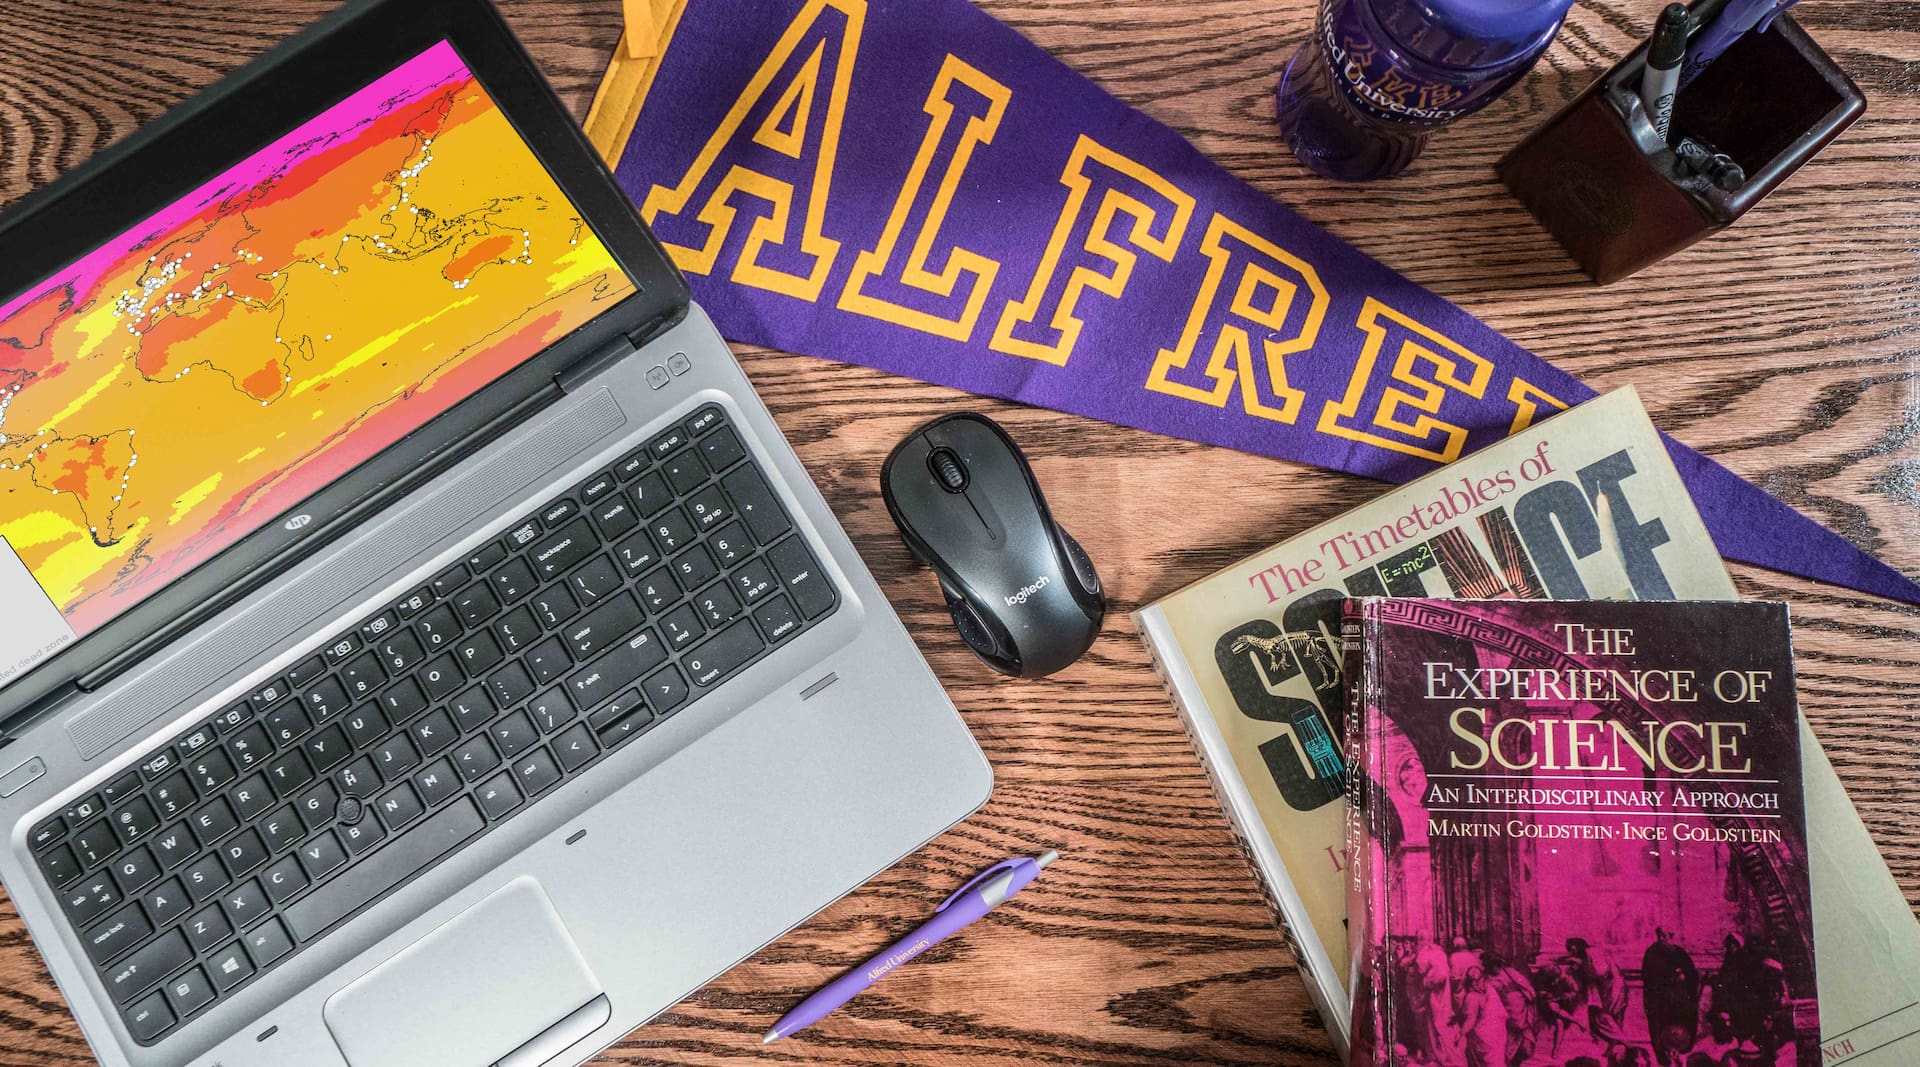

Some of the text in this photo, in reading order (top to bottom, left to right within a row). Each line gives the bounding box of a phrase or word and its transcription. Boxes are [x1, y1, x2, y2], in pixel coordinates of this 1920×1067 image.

[1344, 58, 1466, 119] University
[639, 0, 1570, 464] ALFRE
[626, 460, 639, 471] end
[587, 482, 605, 495] home
[548, 506, 567, 520] delete
[696, 504, 705, 513] 9
[286, 514, 311, 530] hp
[1249, 441, 1557, 604] The Timetables of
[512, 524, 532, 538] insert
[660, 527, 669, 536] 8
[719, 540, 728, 549] 6
[538, 539, 571, 561] backspace
[623, 549, 631, 559] 7
[630, 555, 649, 568] home
[682, 563, 691, 573] 5
[741, 577, 750, 586] 3
[792, 571, 808, 585] enter
[647, 586, 655, 595] 4
[1004, 574, 1050, 607] logitech
[705, 600, 714, 610] 2
[670, 623, 677, 631] 1
[774, 621, 793, 636] delete
[432, 634, 441, 643] 0
[574, 627, 590, 640] enter
[676, 631, 689, 641] end
[45, 634, 69, 652] zone
[1554, 623, 1636, 656] THE
[466, 648, 474, 658] P
[395, 658, 403, 667] 9
[692, 661, 701, 670] 0
[429, 671, 440, 681] O
[700, 669, 719, 682] insert
[357, 682, 366, 691] 8
[1423, 662, 1772, 703] EXPERIENCE OF
[390, 698, 397, 706] I
[319, 705, 327, 715] 7
[459, 705, 469, 714] L
[353, 719, 363, 729] U
[282, 729, 290, 738] 6
[421, 726, 432, 737] K
[1449, 707, 1751, 774] SCIENCE
[315, 742, 324, 752] Y
[244, 753, 252, 763] 5
[384, 751, 392, 761] J
[276, 767, 285, 777] T
[206, 777, 214, 786] 4
[345, 774, 356, 785] H
[425, 775, 437, 787] M
[1351, 681, 1362, 892] THE EXPERIENCE
[239, 792, 250, 802] R
[1427, 783, 1779, 810] AN INTERDISCIPLINARY APPROACH
[166, 802, 176, 811] 3
[308, 799, 319, 809] G
[386, 800, 398, 811] N
[200, 815, 211, 826] E
[128, 826, 137, 836] 2
[269, 823, 278, 834] F
[349, 828, 360, 838] B
[1427, 818, 1782, 843] MARTIN GOLDSTEIN INGE GOLDSTEIN
[162, 836, 176, 849] W
[231, 847, 241, 858] D
[309, 848, 319, 858] V
[124, 864, 136, 874] Q
[193, 872, 203, 882] S
[273, 873, 283, 883] C
[156, 896, 167, 907] A
[233, 897, 245, 908] X
[195, 922, 206, 933] Z
[867, 936, 931, 982] Alfred University
